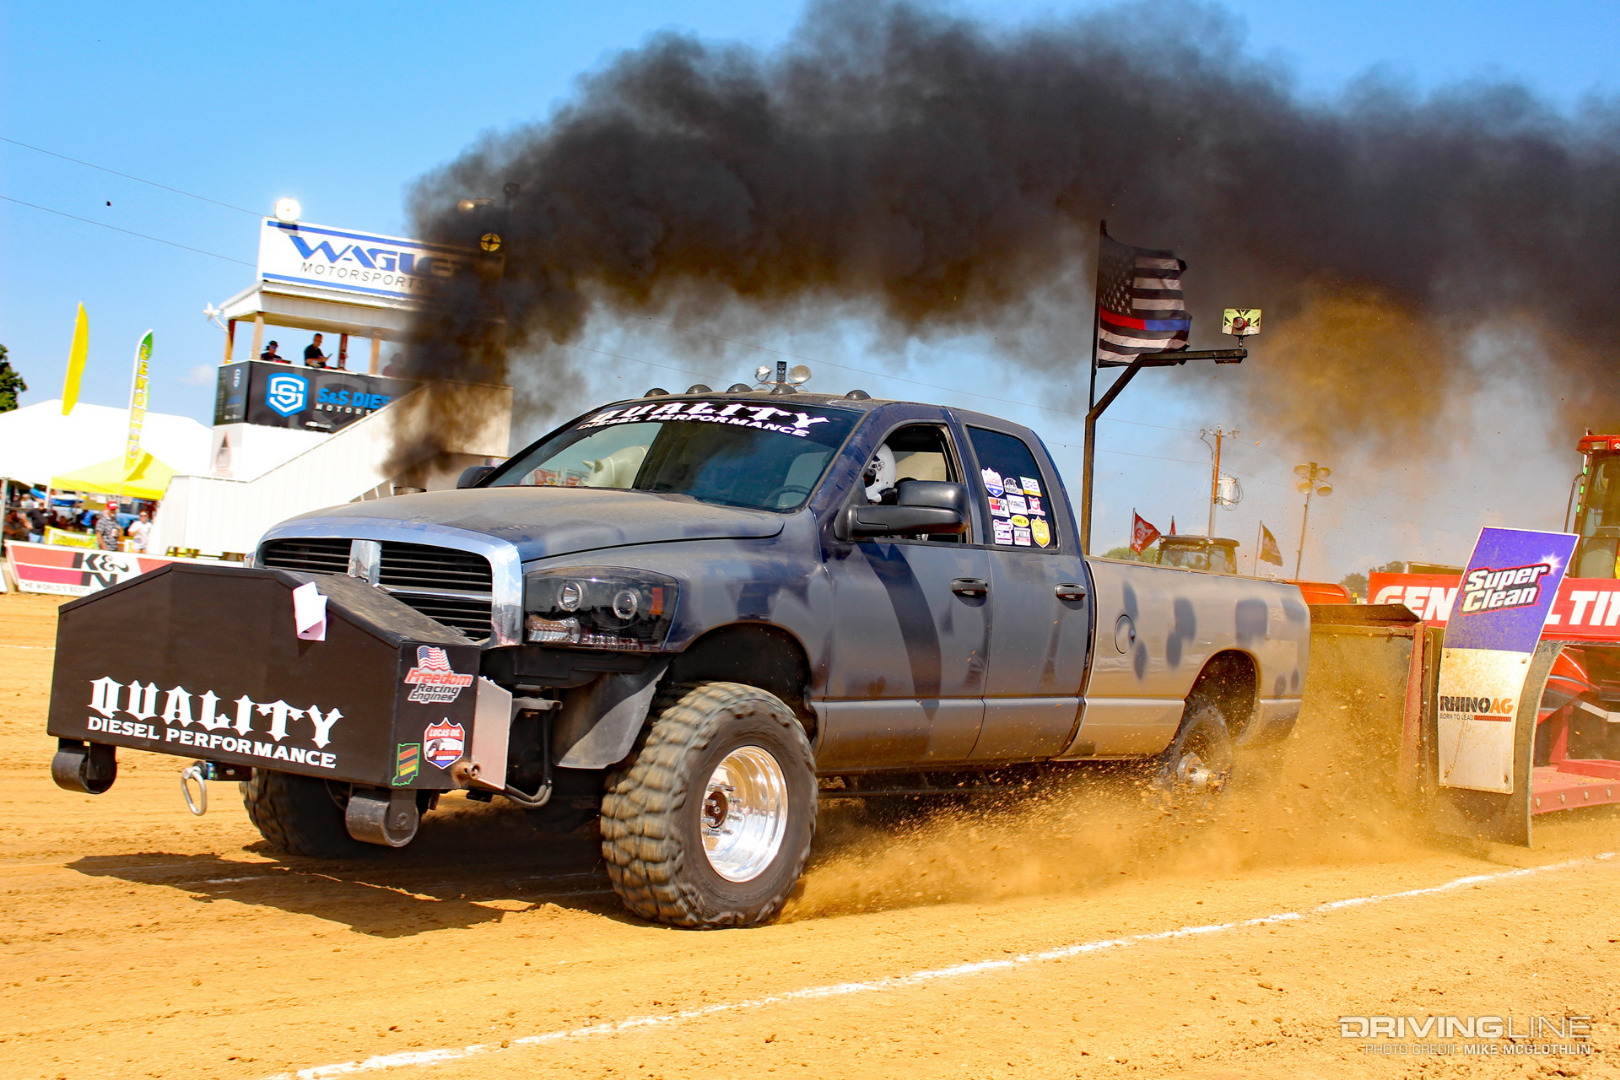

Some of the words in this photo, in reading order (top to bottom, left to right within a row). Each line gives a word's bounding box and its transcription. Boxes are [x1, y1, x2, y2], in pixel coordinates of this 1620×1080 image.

[317, 388, 350, 405] S&S
[576, 416, 641, 431] DIESEL
[646, 414, 810, 437] PERFORMANCE
[585, 402, 830, 429] QUALITY
[1465, 565, 1549, 591] Super
[1461, 586, 1539, 613] Clean
[407, 669, 473, 686] Freedom
[410, 690, 453, 702] Engines
[418, 683, 460, 697] Racing
[87, 676, 344, 749] QUALITY
[87, 716, 160, 740] DIESEL
[165, 728, 337, 769] PERFORMANCE
[429, 729, 450, 737] LUCAS
[450, 729, 461, 737] OIL
